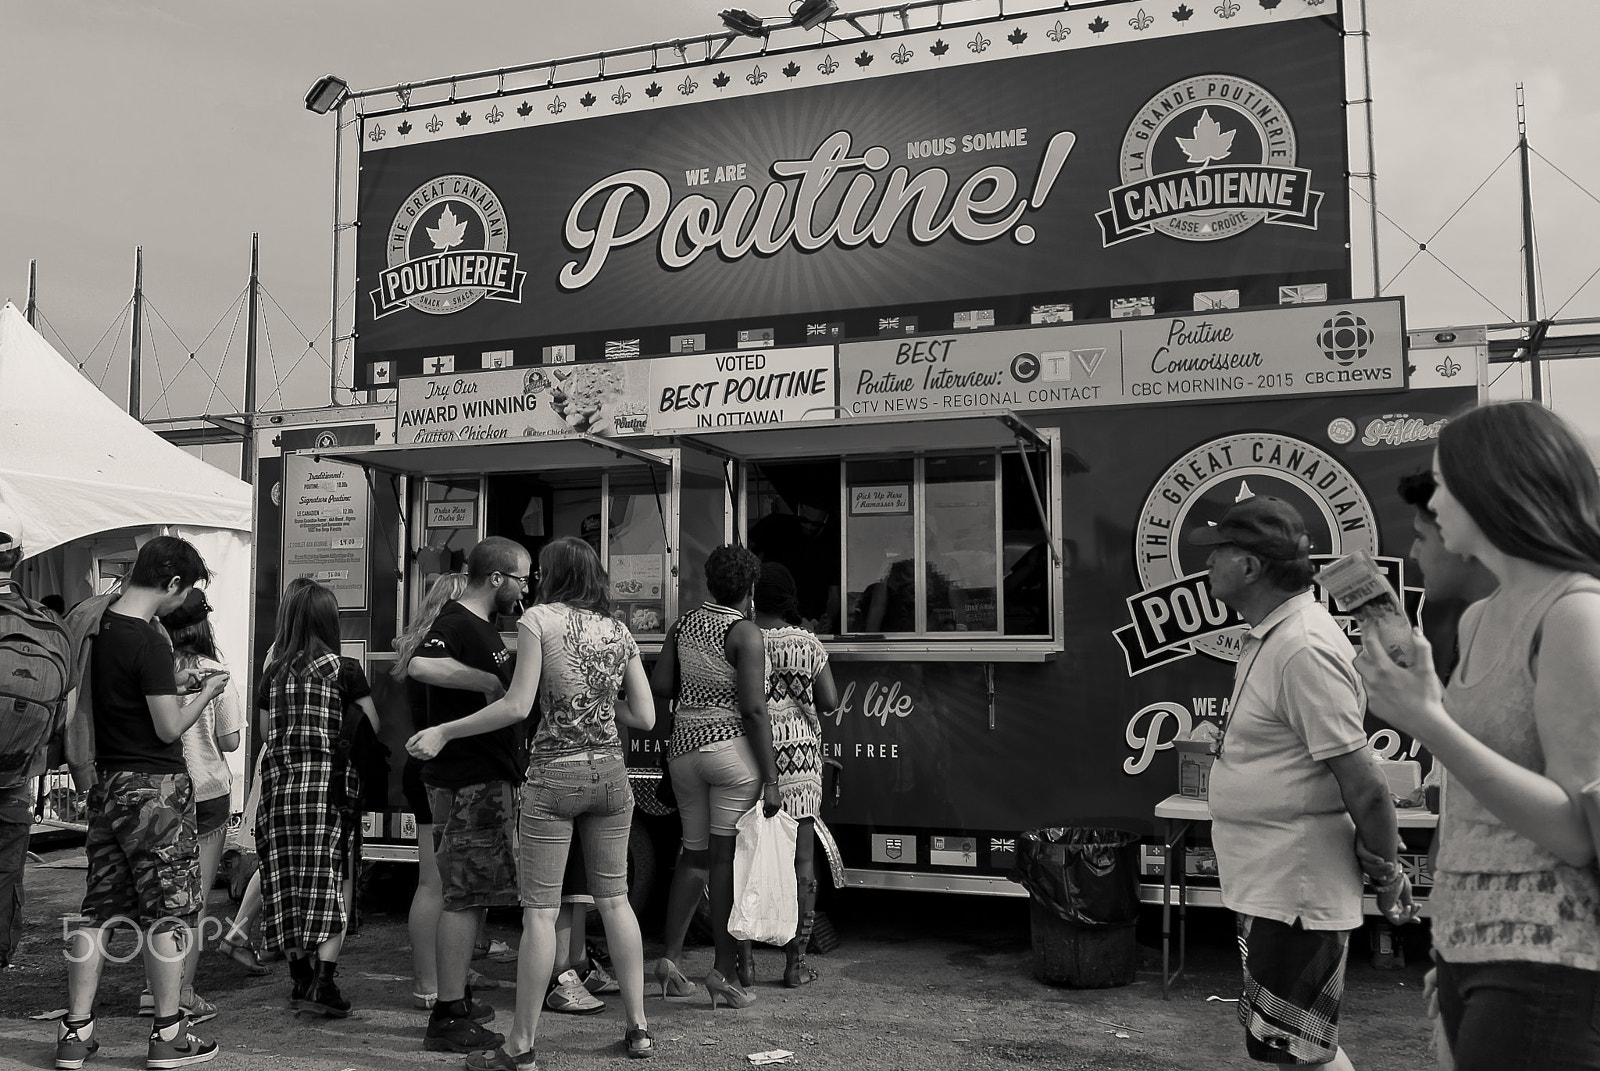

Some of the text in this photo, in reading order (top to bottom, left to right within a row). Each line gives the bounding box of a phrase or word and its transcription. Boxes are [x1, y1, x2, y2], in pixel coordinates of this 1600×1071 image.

[1129, 83, 1287, 171] LA GRANDE POUTINERIE
[908, 128, 1028, 160] NOUS SOMME
[686, 164, 747, 187] WE ARE
[559, 130, 1077, 290] Poutine!
[1124, 172, 1297, 221] CANADIENNE
[392, 181, 503, 251] THE GREAT CANADIAN
[1169, 211, 1248, 233] CASSE CROÛTE
[386, 255, 509, 300] POUTINERIE
[420, 290, 475, 308] SNACK SHACK
[1167, 319, 1234, 346] Poutine
[715, 354, 766, 372] VOTED
[895, 339, 957, 365] BEST
[1010, 347, 1107, 383] CTV
[1151, 347, 1264, 376] Connoisseur
[424, 379, 478, 399] Try Our
[658, 368, 829, 414] BEST POUTINE
[856, 365, 1004, 395] Poutine Interview:
[1131, 381, 1162, 397] CBC
[1167, 377, 1244, 395] MORNING
[1257, 373, 1294, 389] 2015
[400, 394, 537, 428] AWARD WINNING
[852, 400, 879, 414] CTV
[884, 397, 928, 412] NEWS
[943, 391, 1022, 408] REGIONAL
[1028, 385, 1101, 403] CONTACT
[460, 424, 508, 440] Chicken
[697, 413, 712, 428] IN
[1146, 442, 1366, 563] THE GREAT CANADIAN
[1216, 634, 1240, 651] SNA
[863, 681, 915, 727] life
[1192, 697, 1218, 717] WE
[855, 743, 899, 759] FREE
